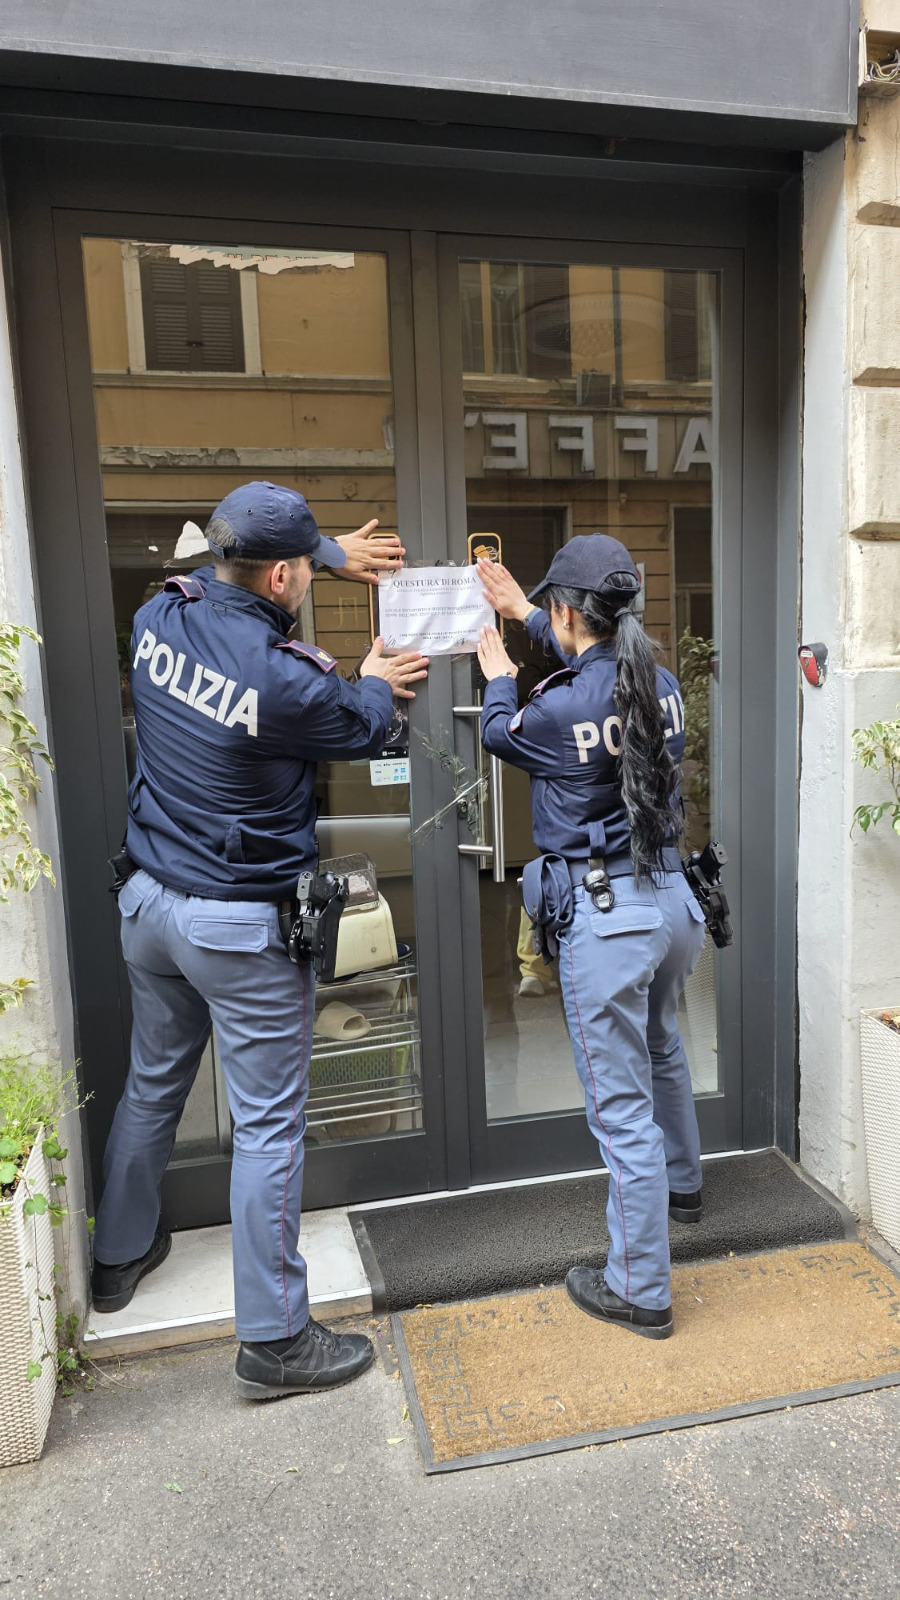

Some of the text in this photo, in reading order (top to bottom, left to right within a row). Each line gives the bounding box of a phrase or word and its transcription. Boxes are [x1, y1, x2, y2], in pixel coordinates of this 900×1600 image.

[393, 577, 477, 588] QUESTURA DI ROMA
[133, 628, 258, 737] POLIZIA
